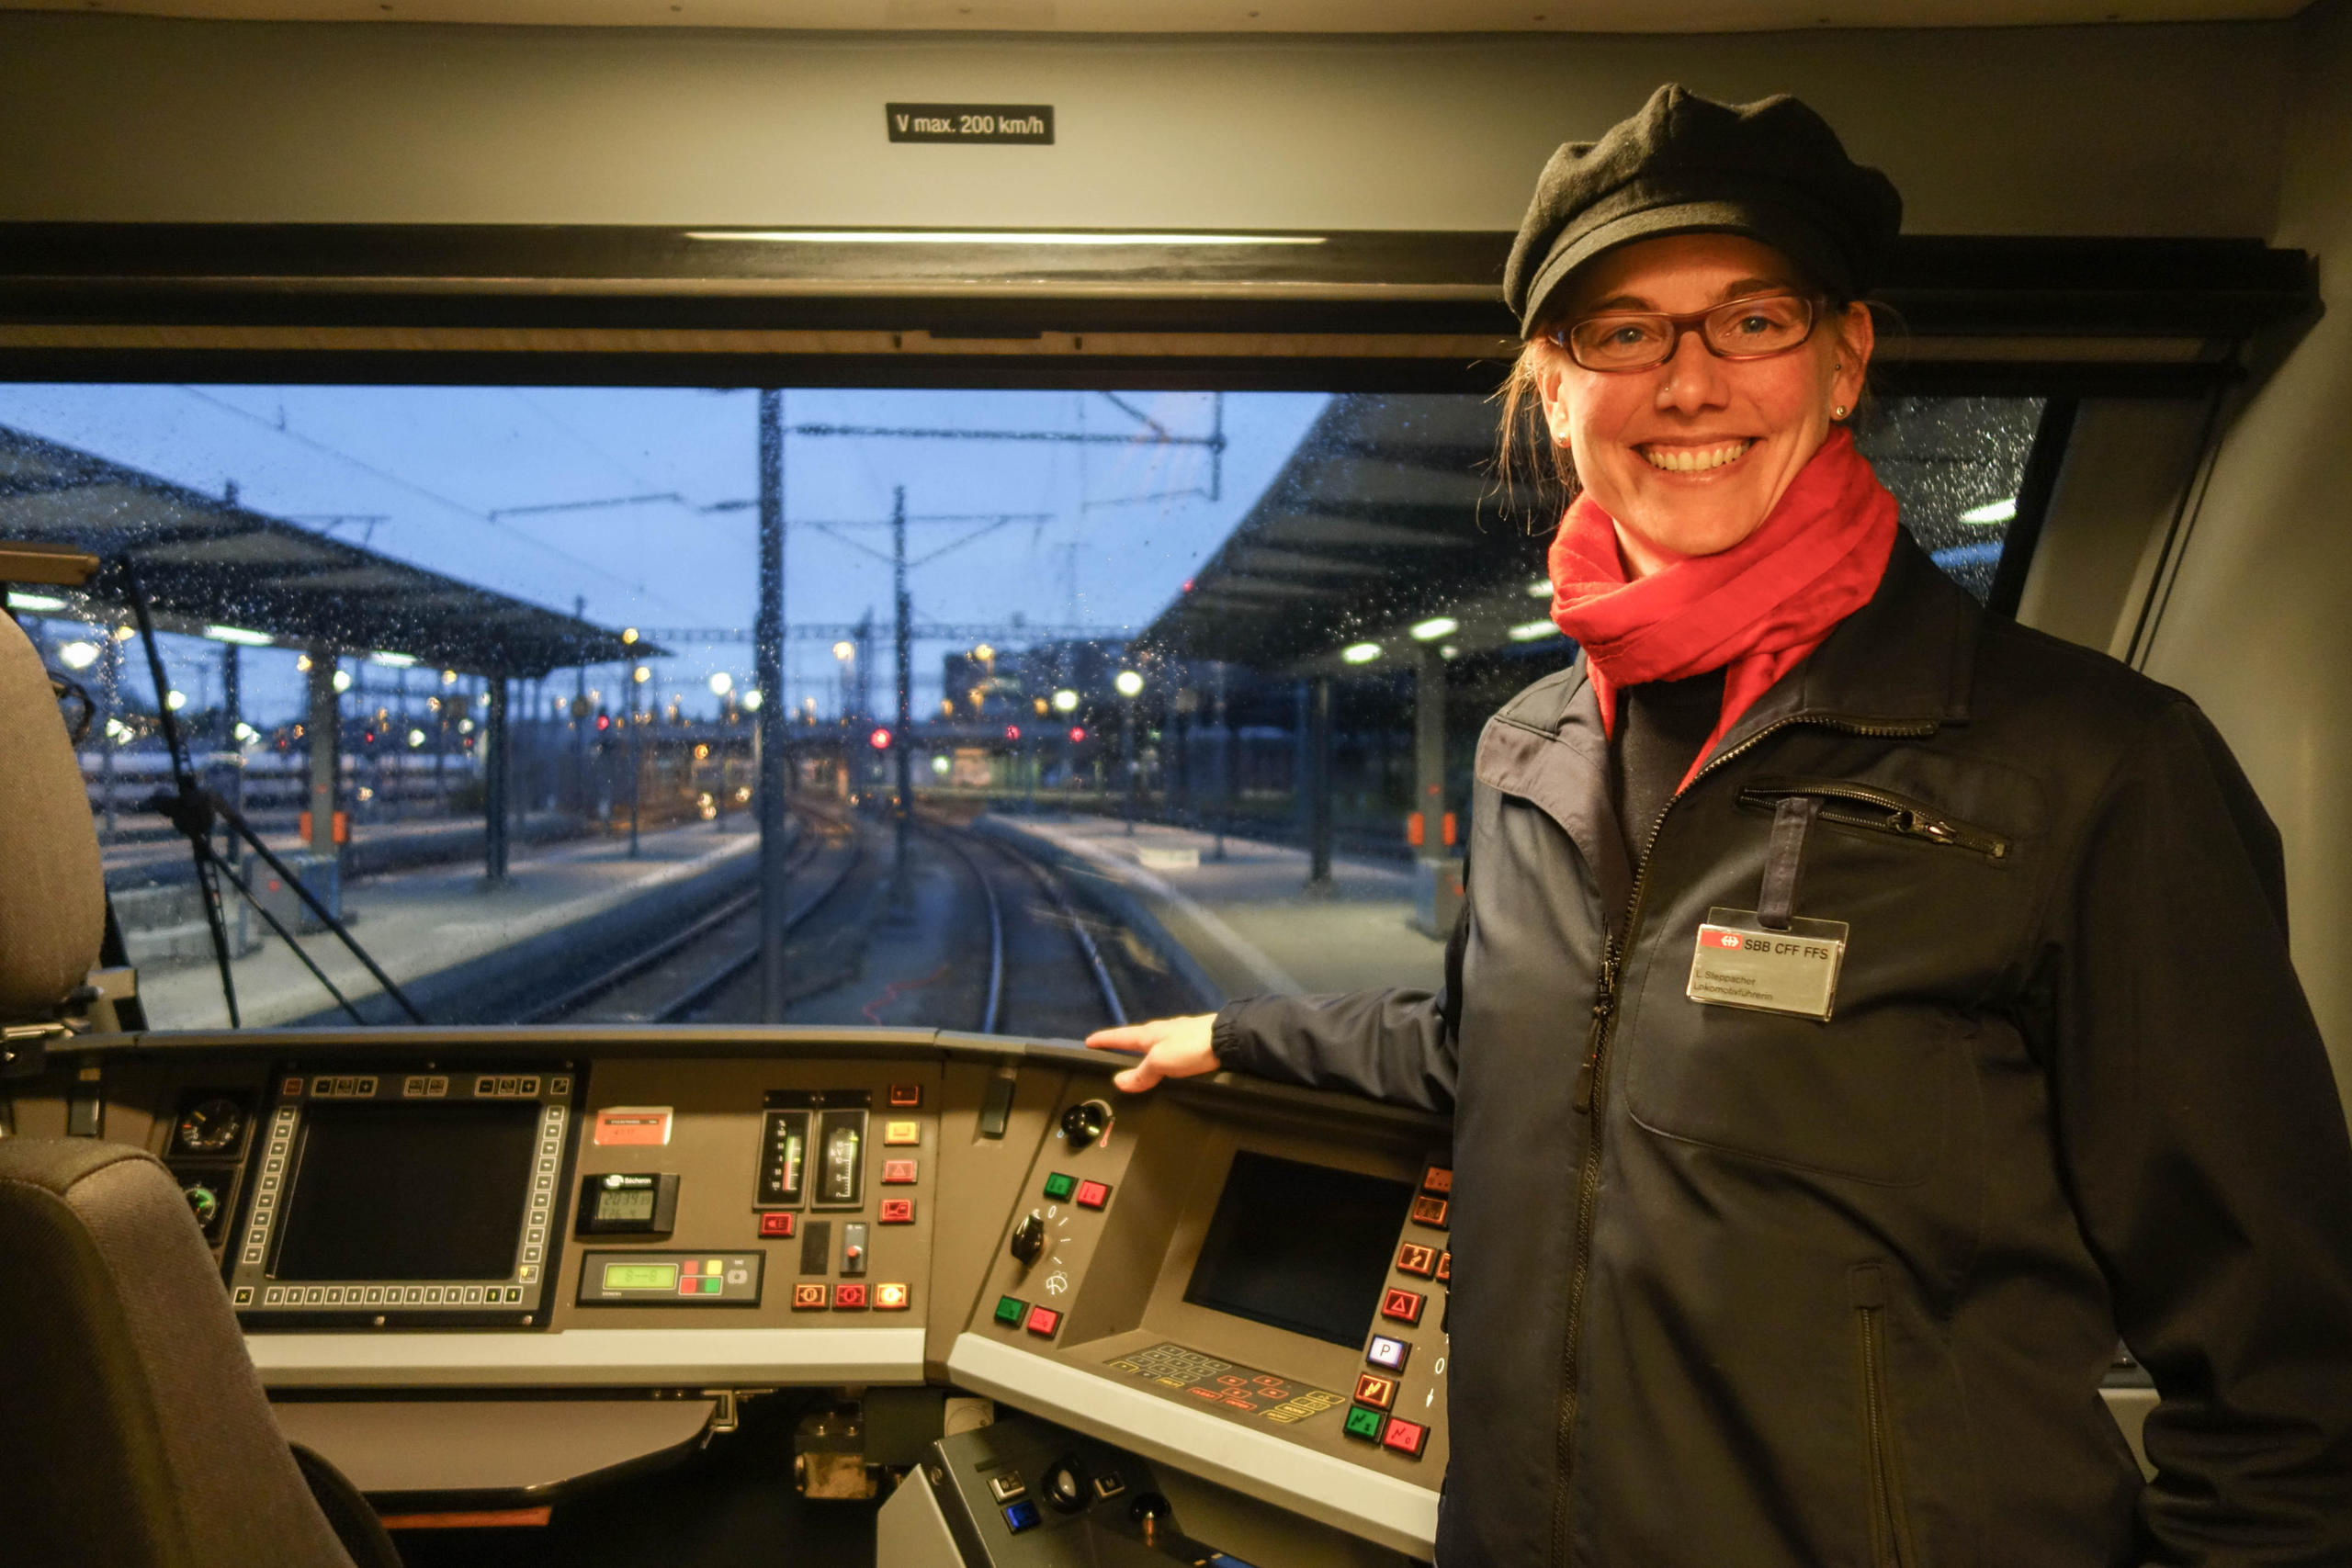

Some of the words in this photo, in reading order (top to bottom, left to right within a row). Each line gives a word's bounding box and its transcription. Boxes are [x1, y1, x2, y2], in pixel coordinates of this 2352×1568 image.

[896, 114, 910, 132] V
[914, 117, 956, 133] max.
[960, 115, 994, 134] 200
[999, 116, 1044, 134] km/h
[1744, 940, 1771, 953] SBB
[1775, 942, 1800, 956] CFF
[1804, 946, 1829, 960] FFS
[1380, 1344, 1391, 1357] P
[1435, 1357, 1445, 1374] 0
